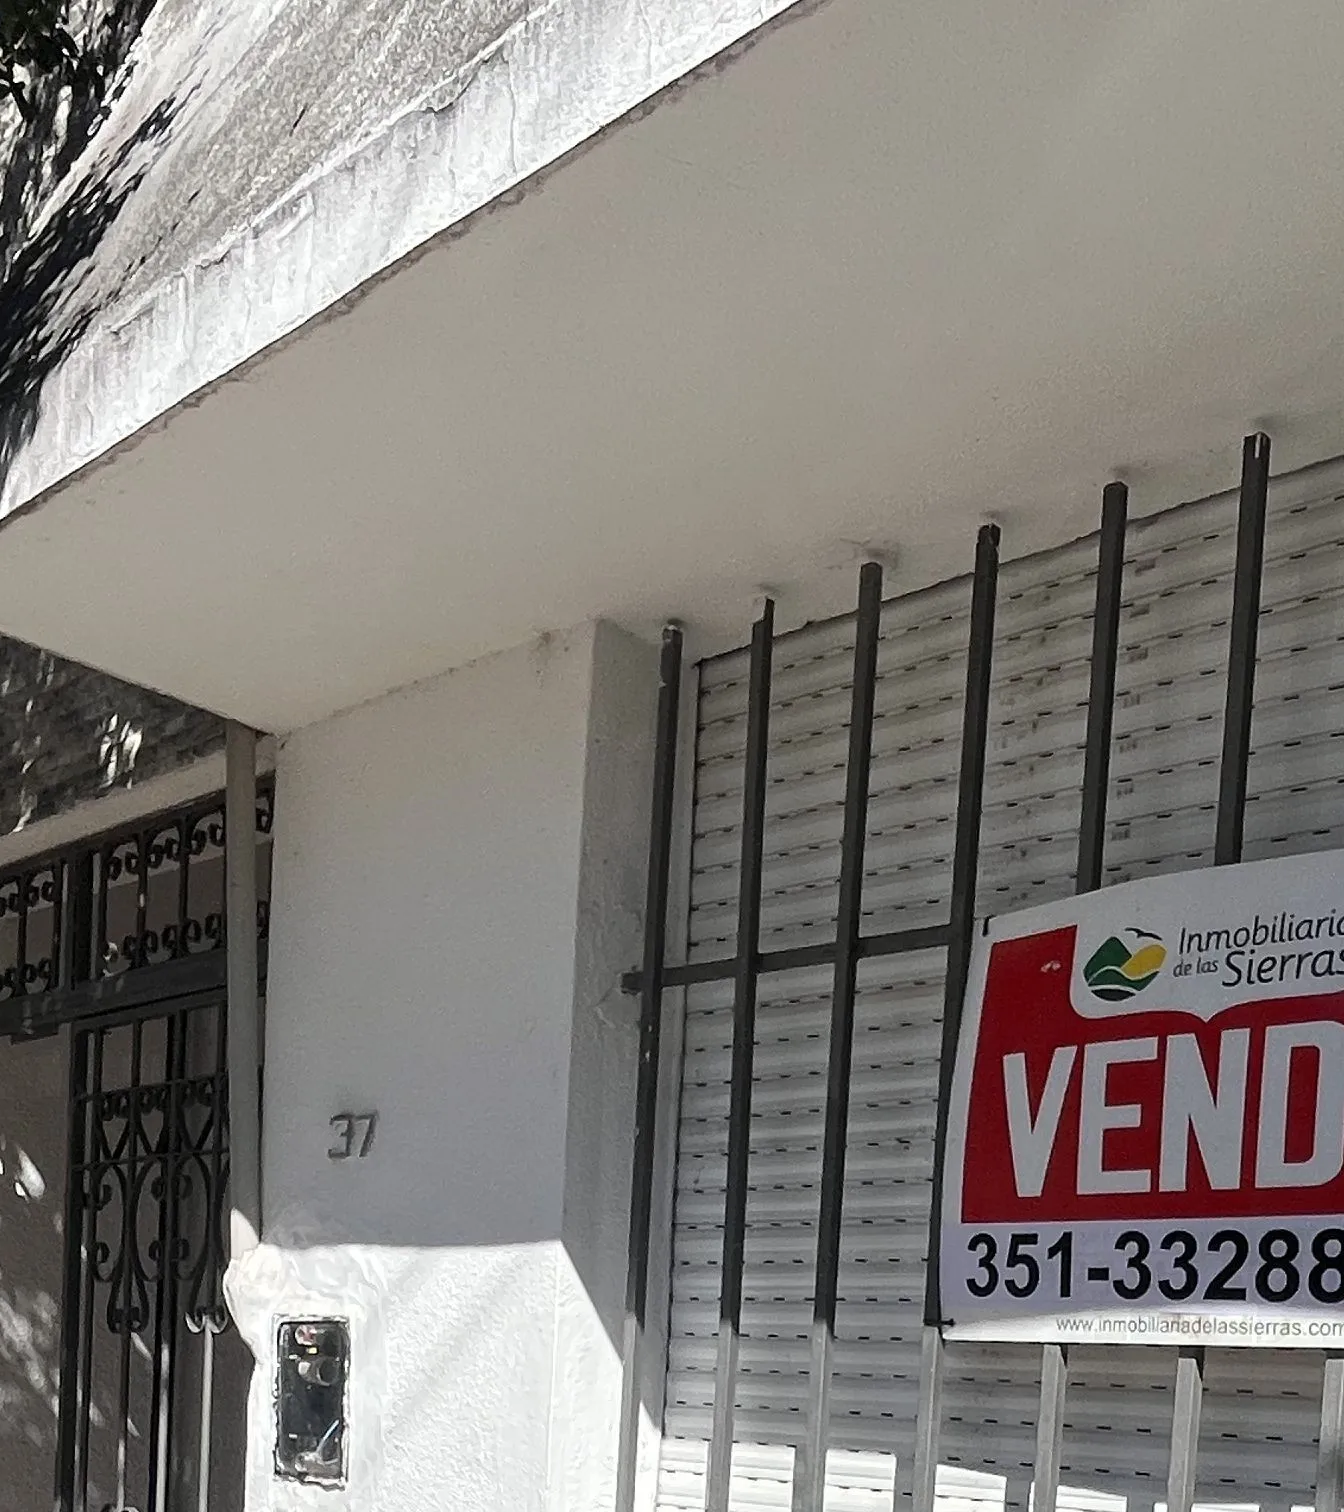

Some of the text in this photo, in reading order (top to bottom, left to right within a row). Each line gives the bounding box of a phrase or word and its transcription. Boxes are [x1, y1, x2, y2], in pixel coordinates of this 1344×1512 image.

[1173, 957, 1192, 977] de
[1196, 956, 1219, 974] las
[328, 1113, 377, 1159] 37
